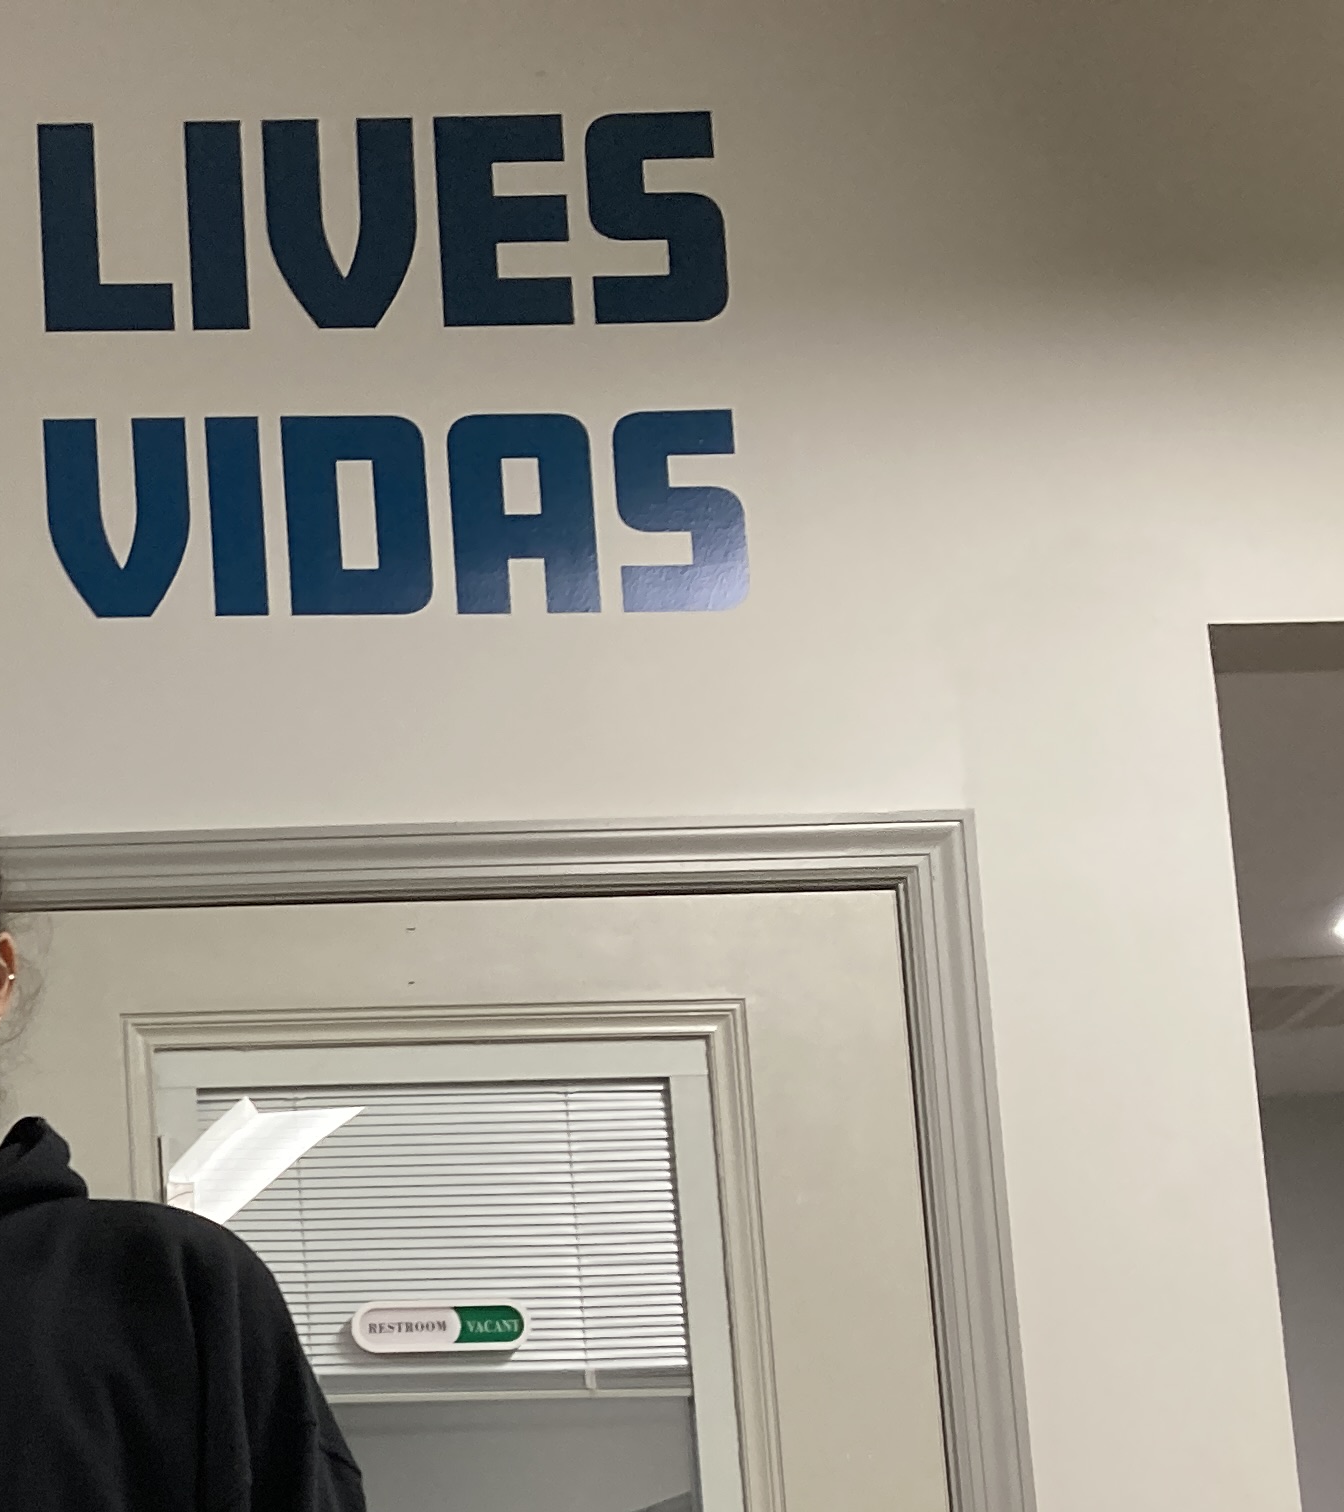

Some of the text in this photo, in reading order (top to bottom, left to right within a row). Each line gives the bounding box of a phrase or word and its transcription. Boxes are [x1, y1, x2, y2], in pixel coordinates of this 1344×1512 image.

[36, 109, 731, 333] LIVES
[44, 408, 752, 619] VIDAS
[368, 1318, 521, 1334] RESTROOM VACANT
